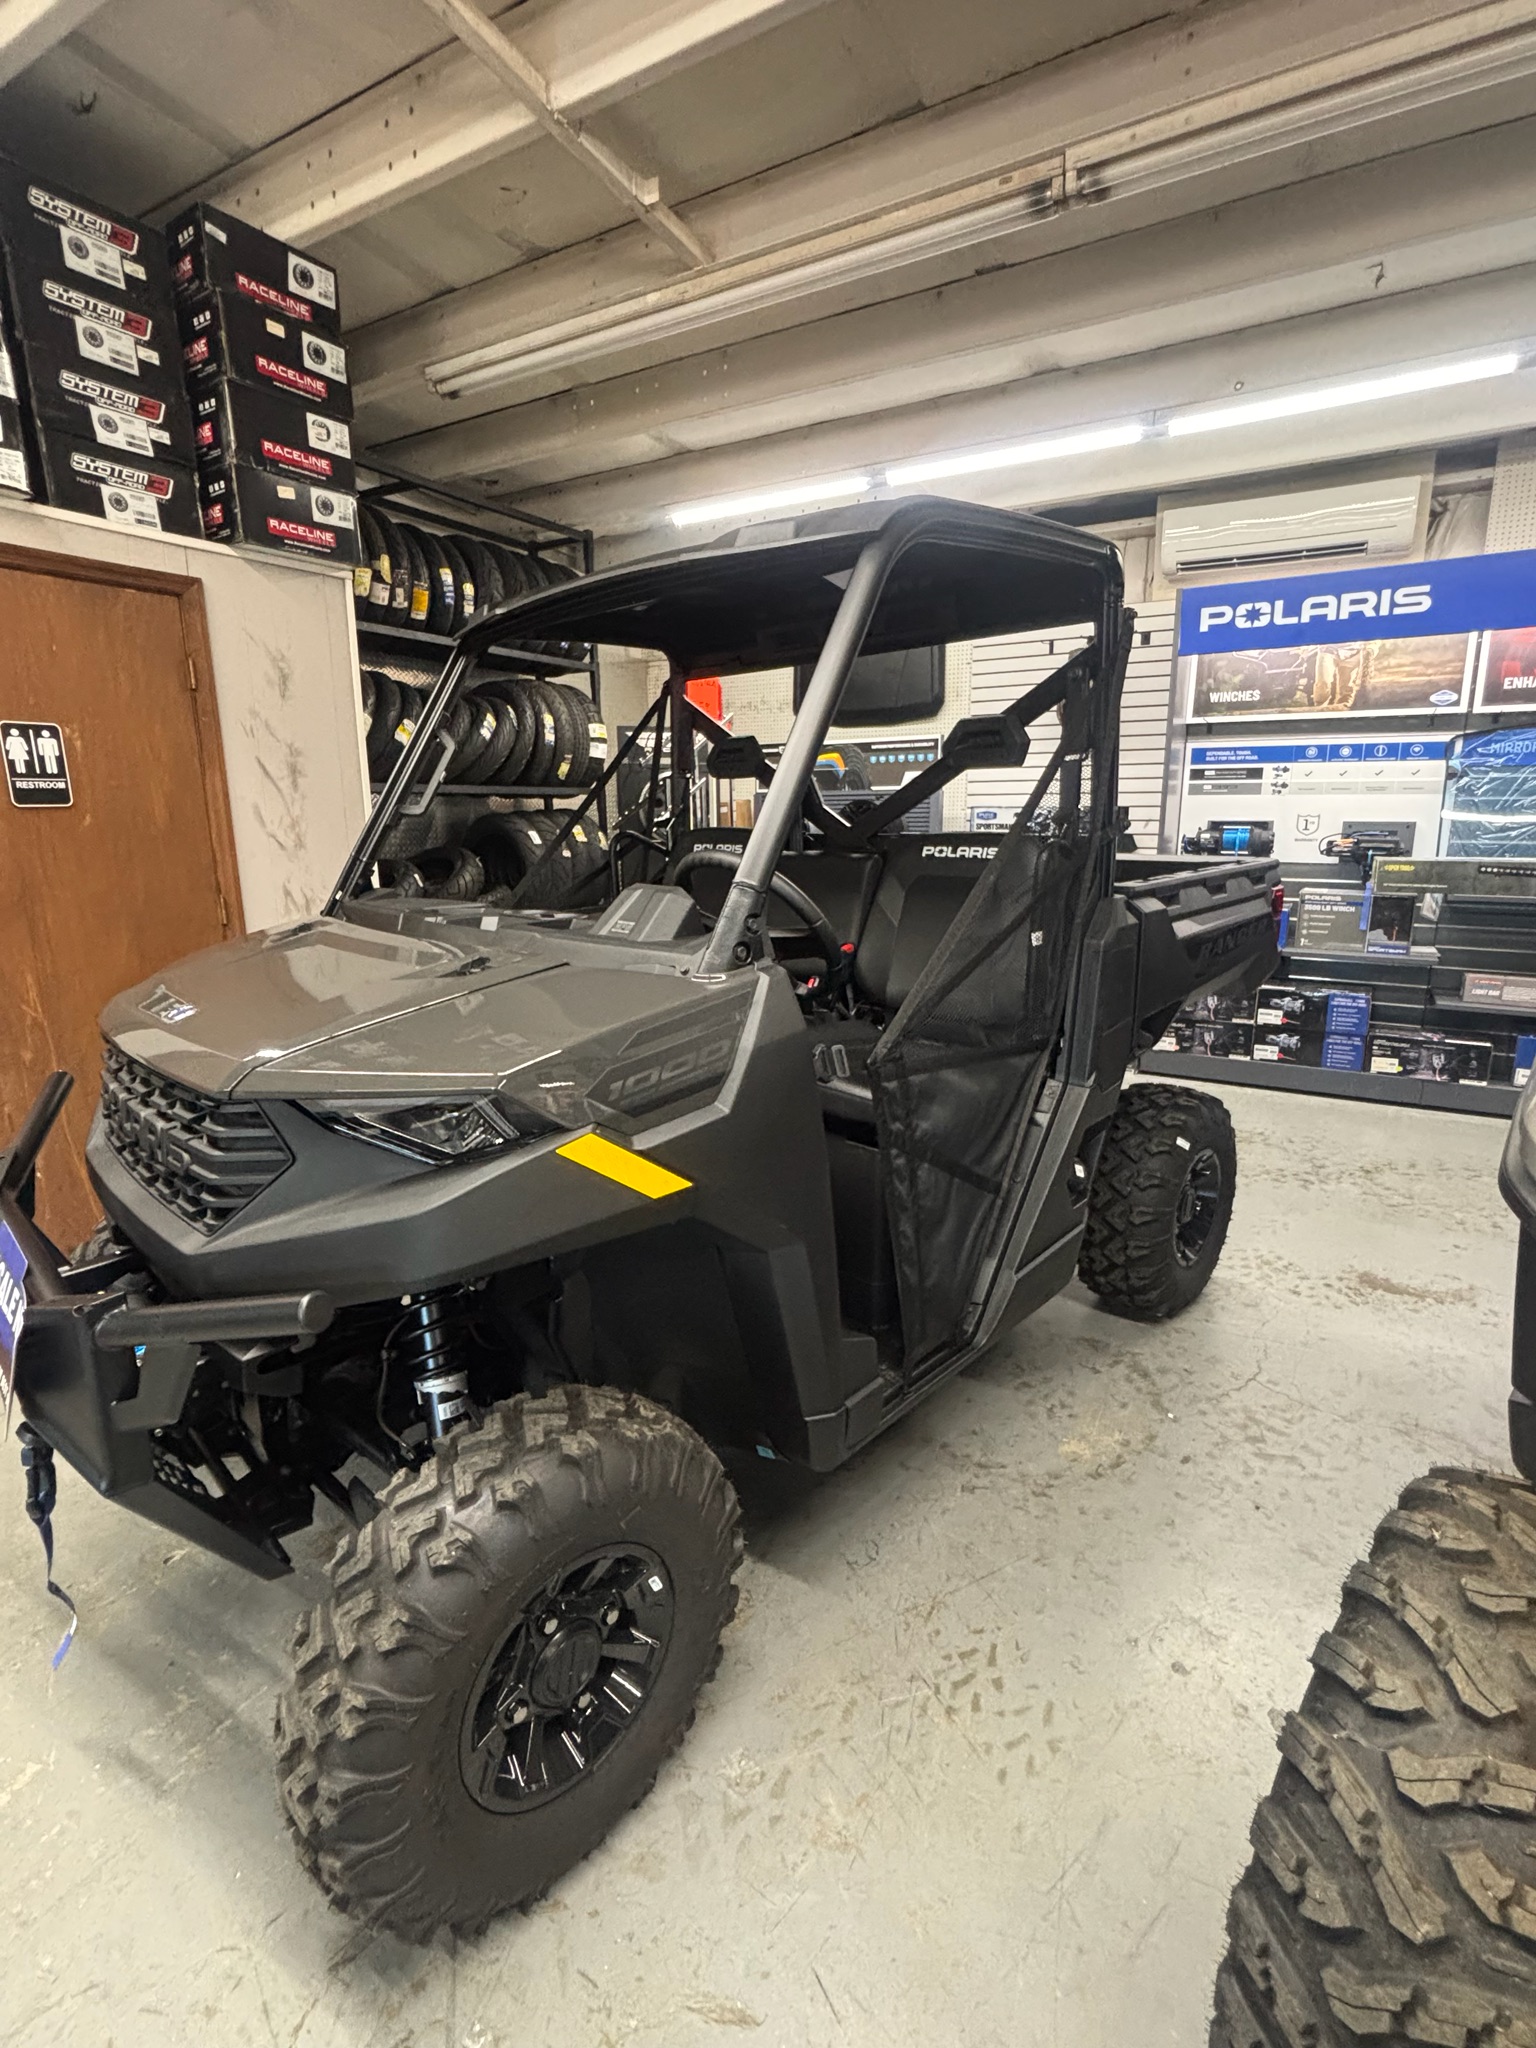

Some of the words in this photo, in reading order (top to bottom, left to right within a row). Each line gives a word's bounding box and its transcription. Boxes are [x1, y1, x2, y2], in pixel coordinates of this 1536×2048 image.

[30, 188, 111, 235] SYSTEM
[44, 282, 125, 322] SYSTEM
[238, 274, 310, 316] RACELINE
[258, 357, 326, 392] RACELINE
[61, 372, 140, 408] SYSTEM
[136, 396, 160, 421] 3
[263, 440, 330, 470] RACELINE
[73, 454, 149, 485] SYSTEM
[146, 475, 169, 497] 3
[269, 518, 335, 542] RACELINE
[1200, 585, 1432, 632] POLARIS
[1209, 689, 1261, 703] WINCHES
[16, 781, 66, 790] RESTROOM
[921, 846, 999, 859] POLARIS
[608, 1038, 733, 1101] 1000
